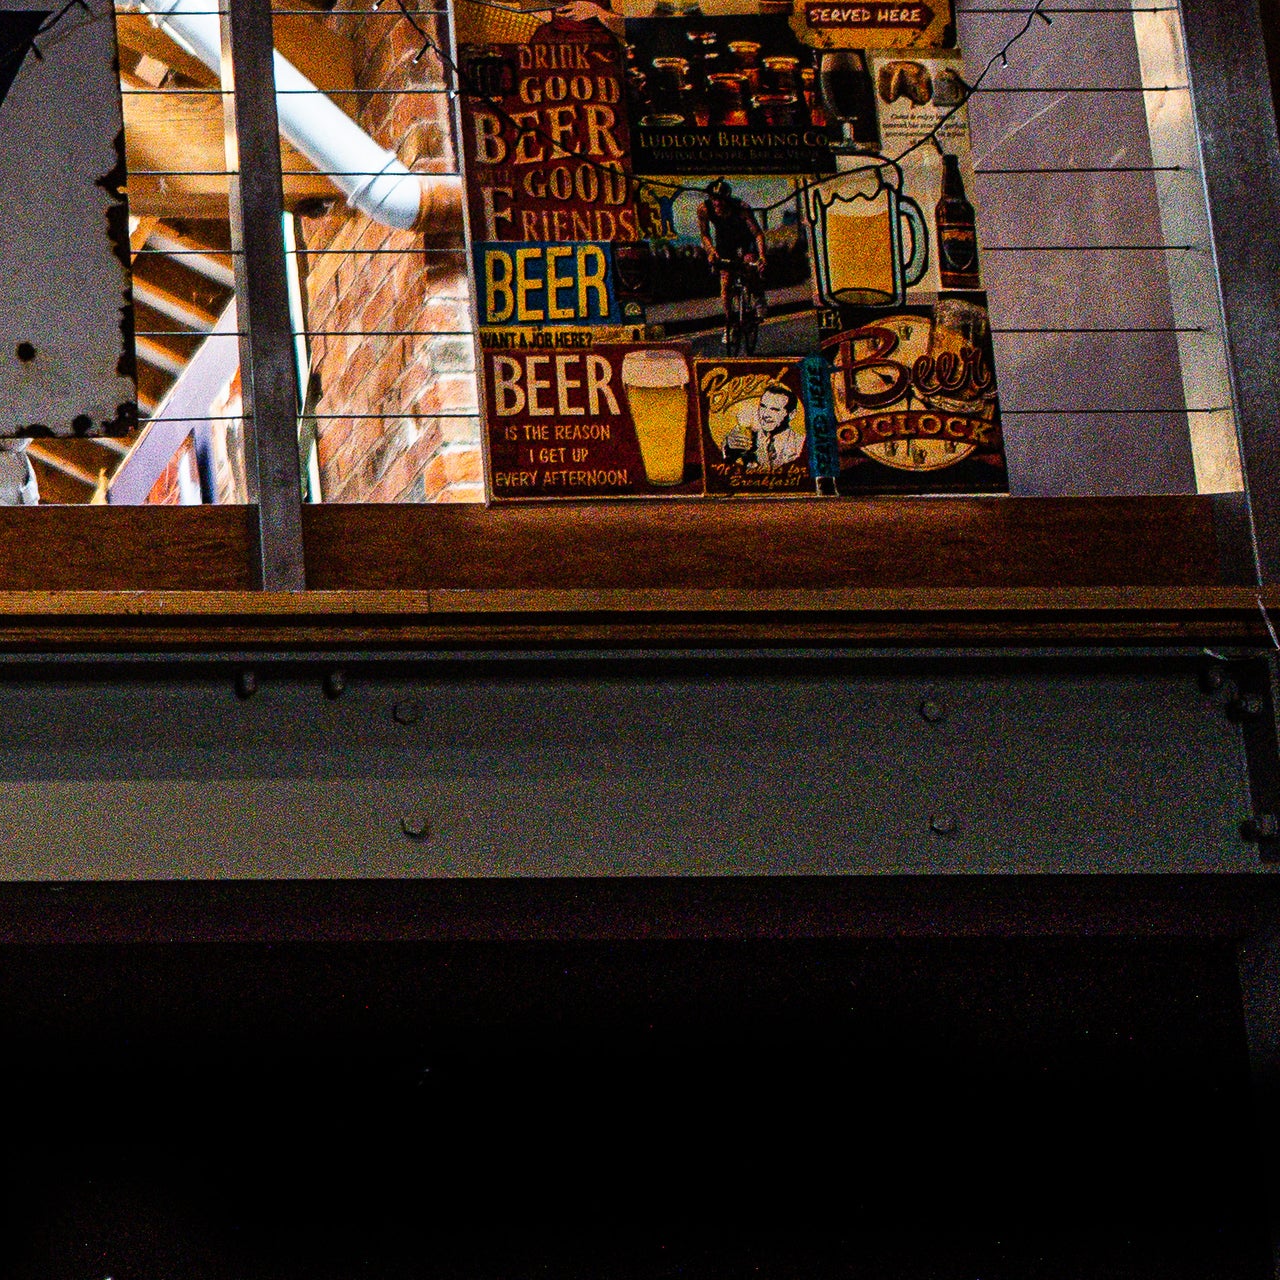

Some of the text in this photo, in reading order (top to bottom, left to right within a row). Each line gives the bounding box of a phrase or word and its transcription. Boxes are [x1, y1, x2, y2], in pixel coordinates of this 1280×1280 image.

[809, 8, 922, 24] SERVED HERE
[518, 44, 591, 71] DRINK
[518, 75, 621, 105] GOOD
[472, 104, 626, 166] BEER
[639, 131, 712, 148] LUDLOW
[718, 131, 799, 148] BREWING
[522, 160, 627, 206] GOOD
[481, 186, 639, 242] FRIENDS
[484, 245, 610, 324] BEER
[481, 332, 593, 349] WANT A JOB HERE?
[820, 326, 999, 411] Beer
[492, 354, 622, 417] BEER
[504, 423, 611, 441] IS THE REASON
[836, 413, 995, 446] O'CLOCK
[529, 447, 590, 464] I GET UP
[495, 469, 634, 487] EVERY AFTERNOON.
